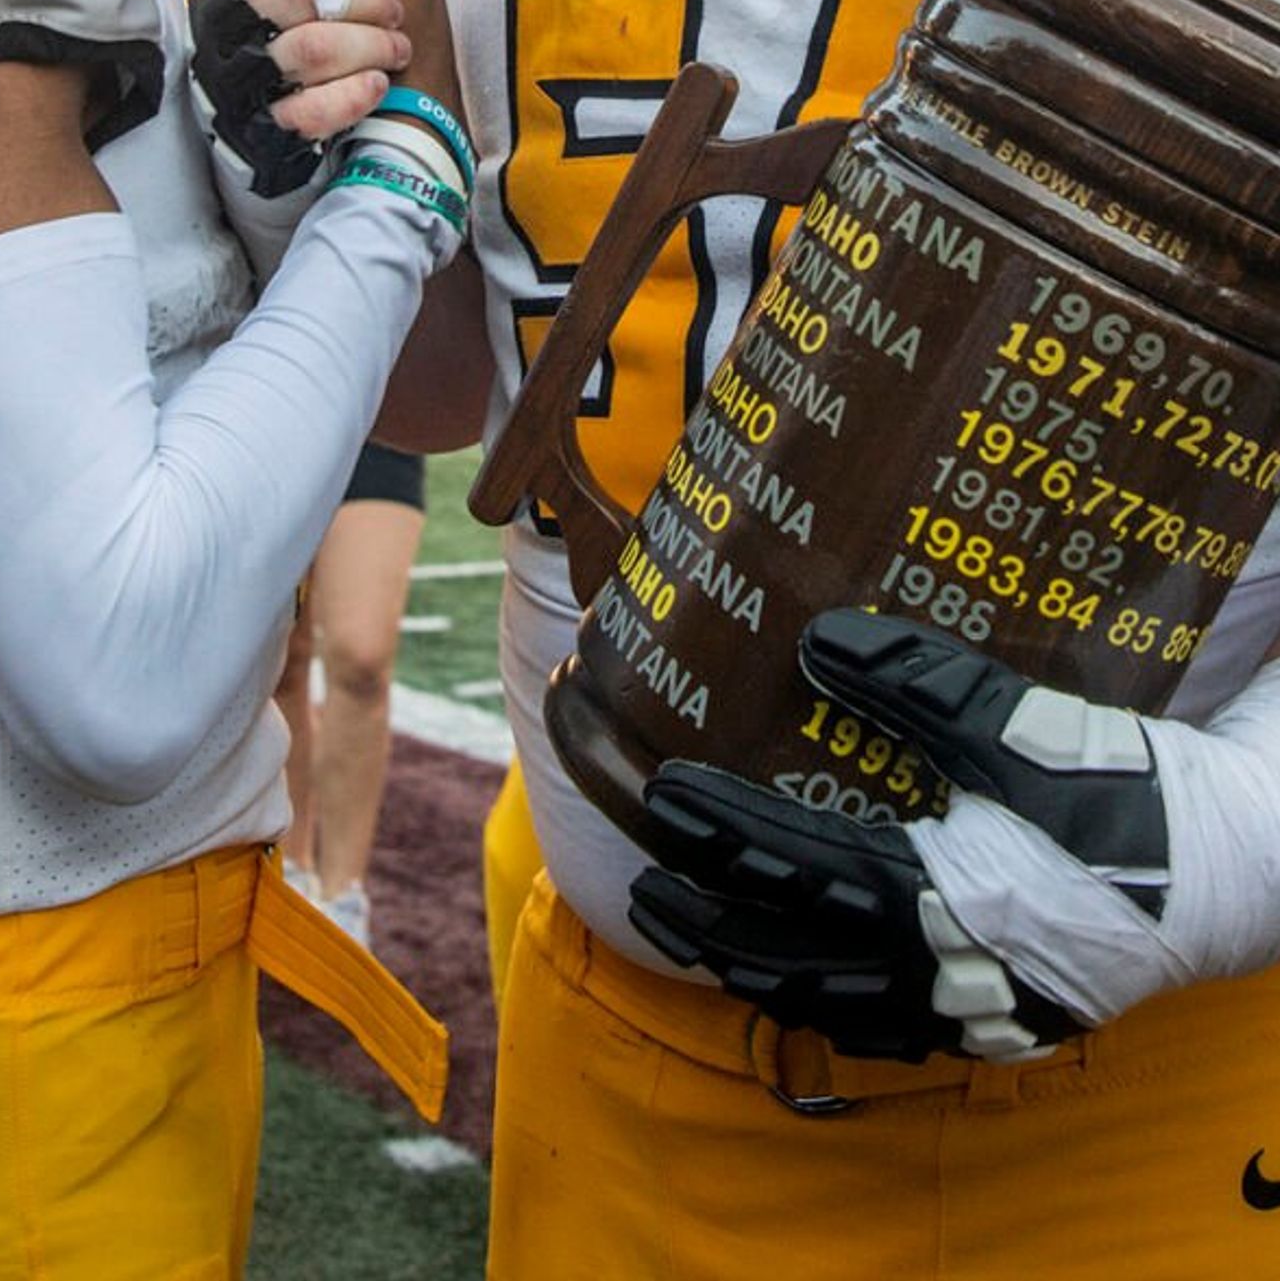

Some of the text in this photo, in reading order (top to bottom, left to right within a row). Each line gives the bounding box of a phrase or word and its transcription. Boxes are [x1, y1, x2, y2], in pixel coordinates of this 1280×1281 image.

[823, 145, 985, 284] MONTANA
[995, 138, 1094, 210] BROWN
[1102, 201, 1192, 261] STEIN
[734, 322, 847, 438] ONTANA
[666, 445, 732, 533] IDAHO
[686, 402, 815, 545] MONTANA
[617, 532, 676, 621] IDAHO
[642, 488, 765, 634] MONTANA
[593, 576, 710, 730] MONTANA
